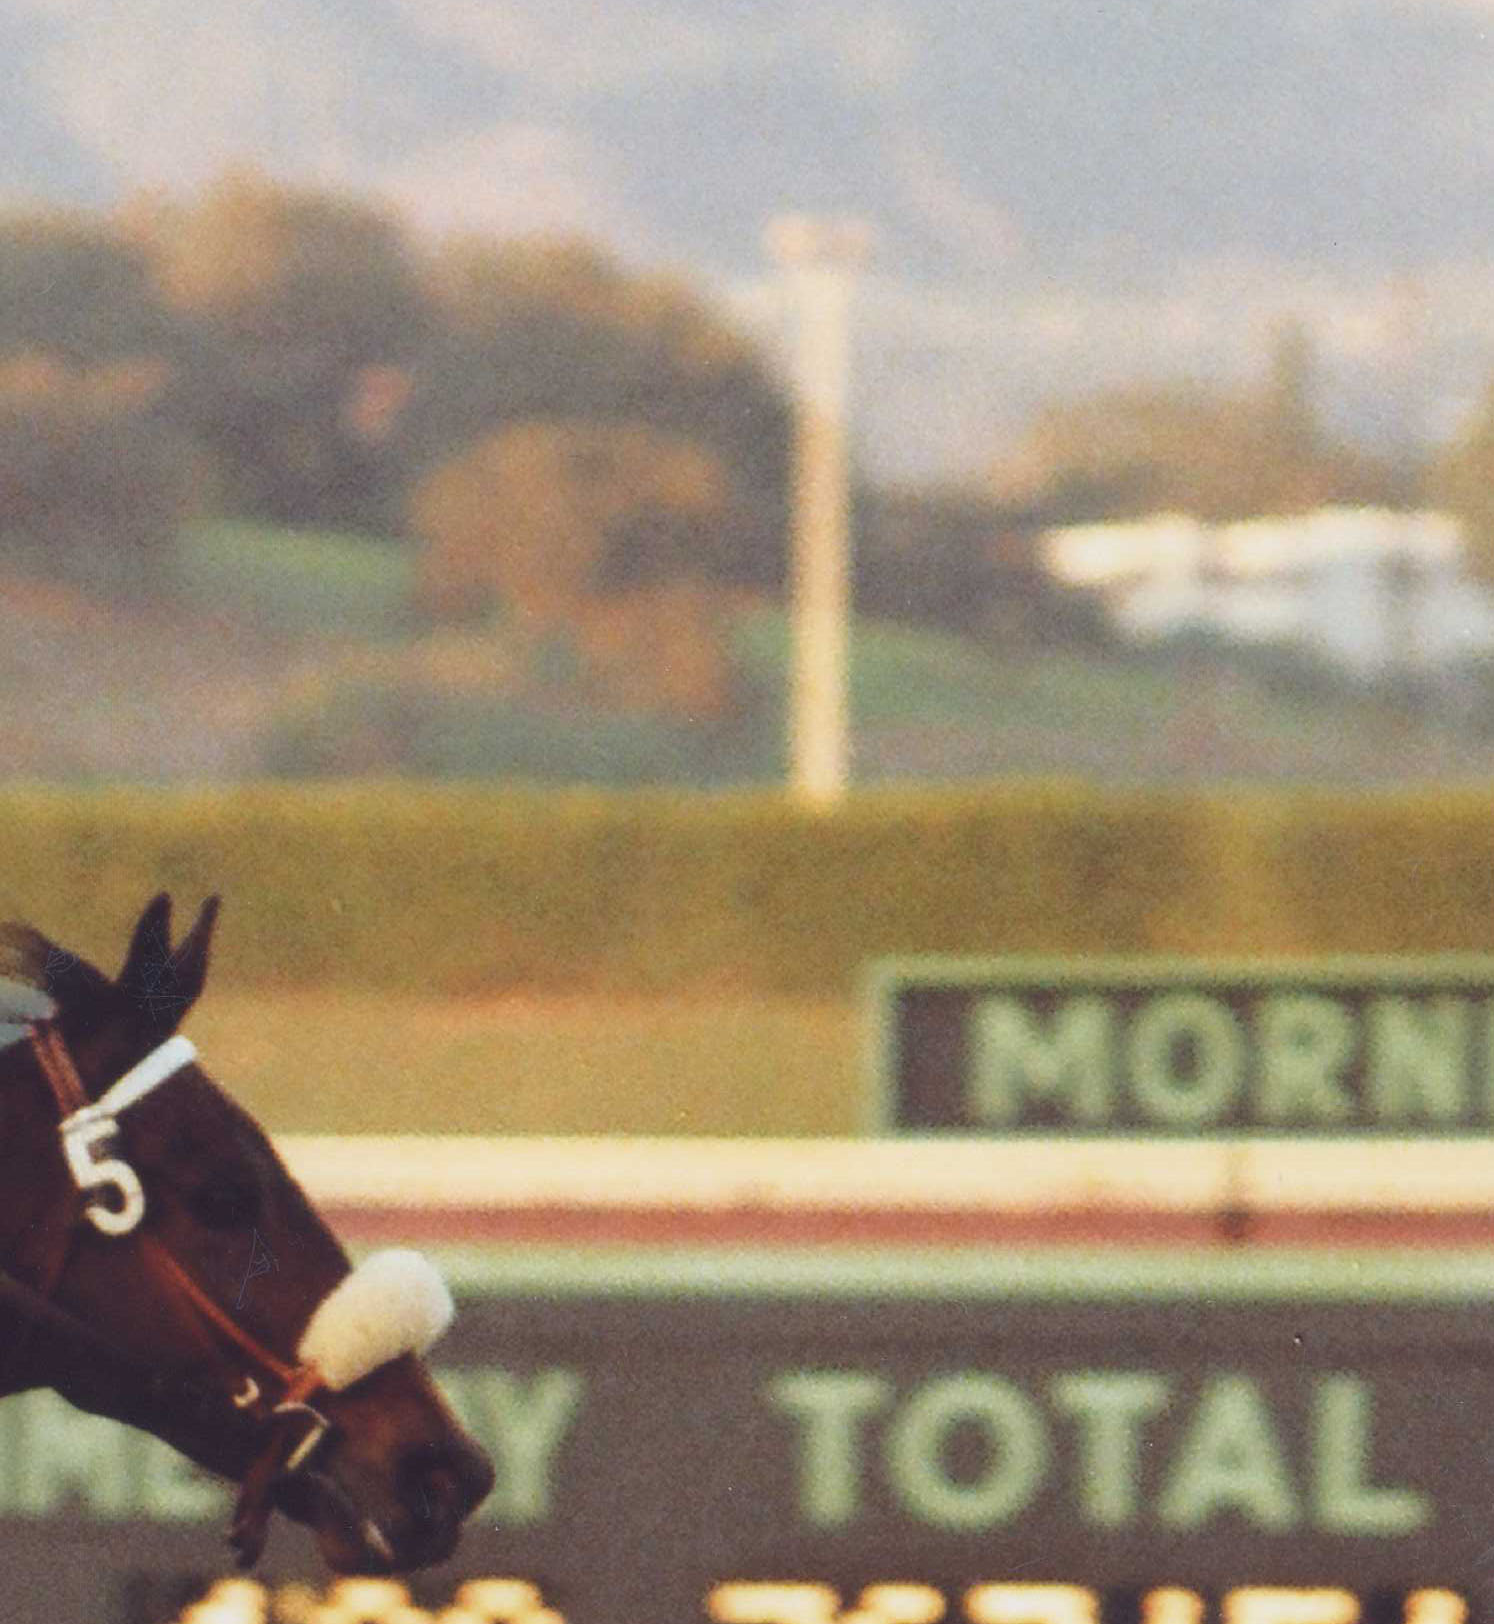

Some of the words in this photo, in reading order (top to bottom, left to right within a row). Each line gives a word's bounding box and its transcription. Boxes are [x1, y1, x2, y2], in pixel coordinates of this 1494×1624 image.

[972, 993, 1494, 1121] MORN
[61, 1116, 145, 1236] 5
[767, 1371, 1434, 1535] TOTAL
